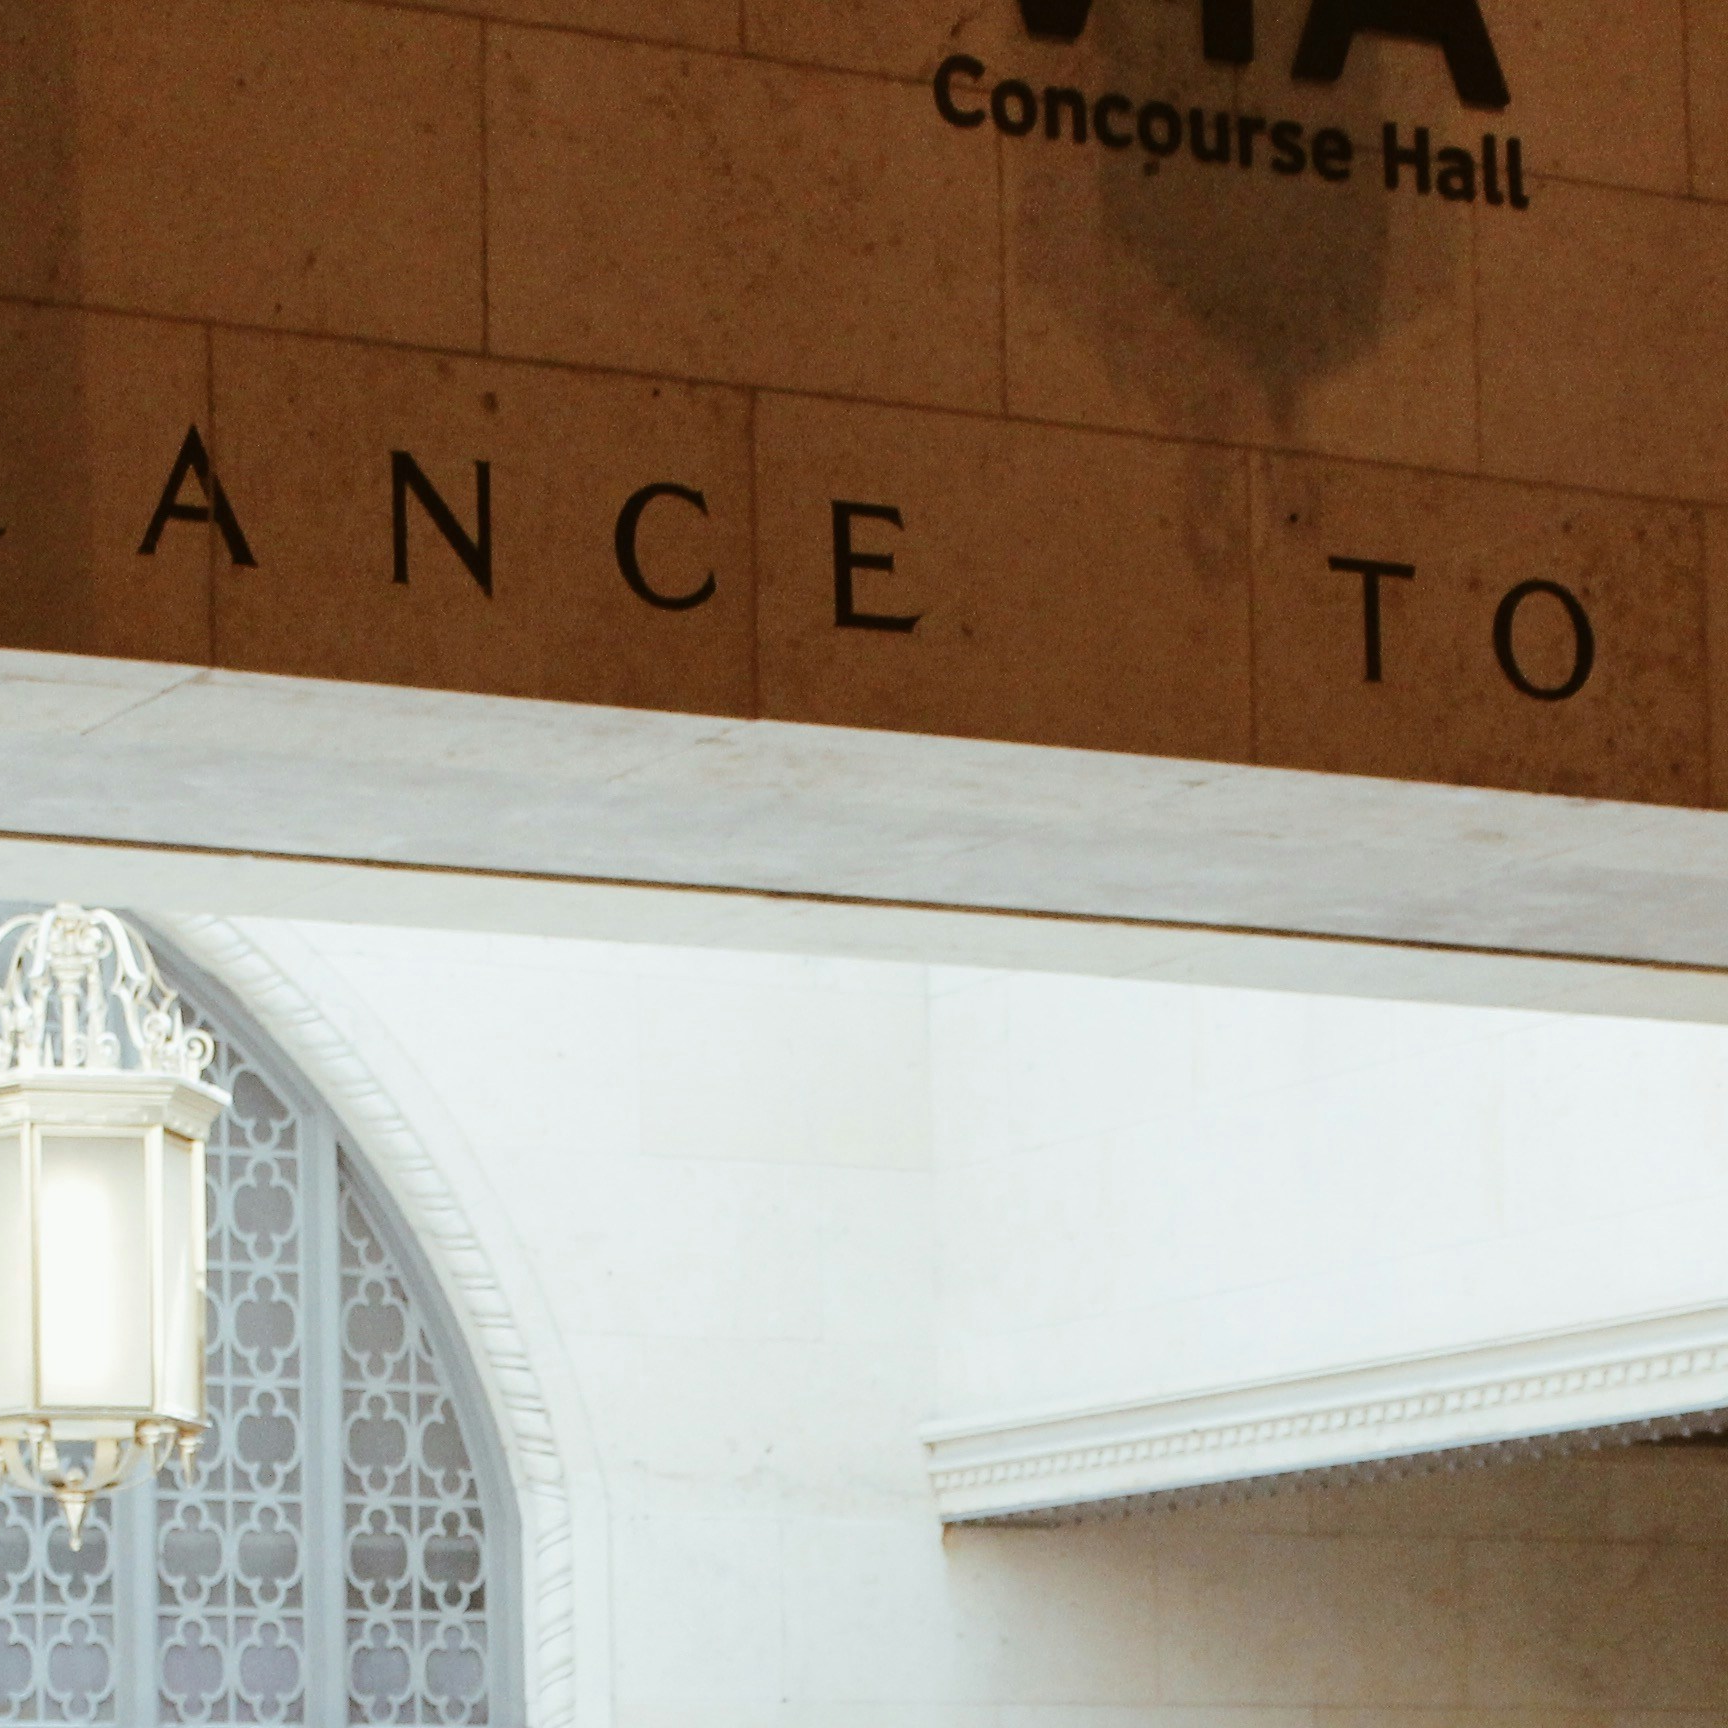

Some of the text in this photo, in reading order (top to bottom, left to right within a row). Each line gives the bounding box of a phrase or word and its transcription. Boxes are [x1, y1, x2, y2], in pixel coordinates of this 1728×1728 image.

[933, 54, 1354, 181] Concourse
[1381, 122, 1530, 209] Hall
[1327, 556, 1595, 702] TO
